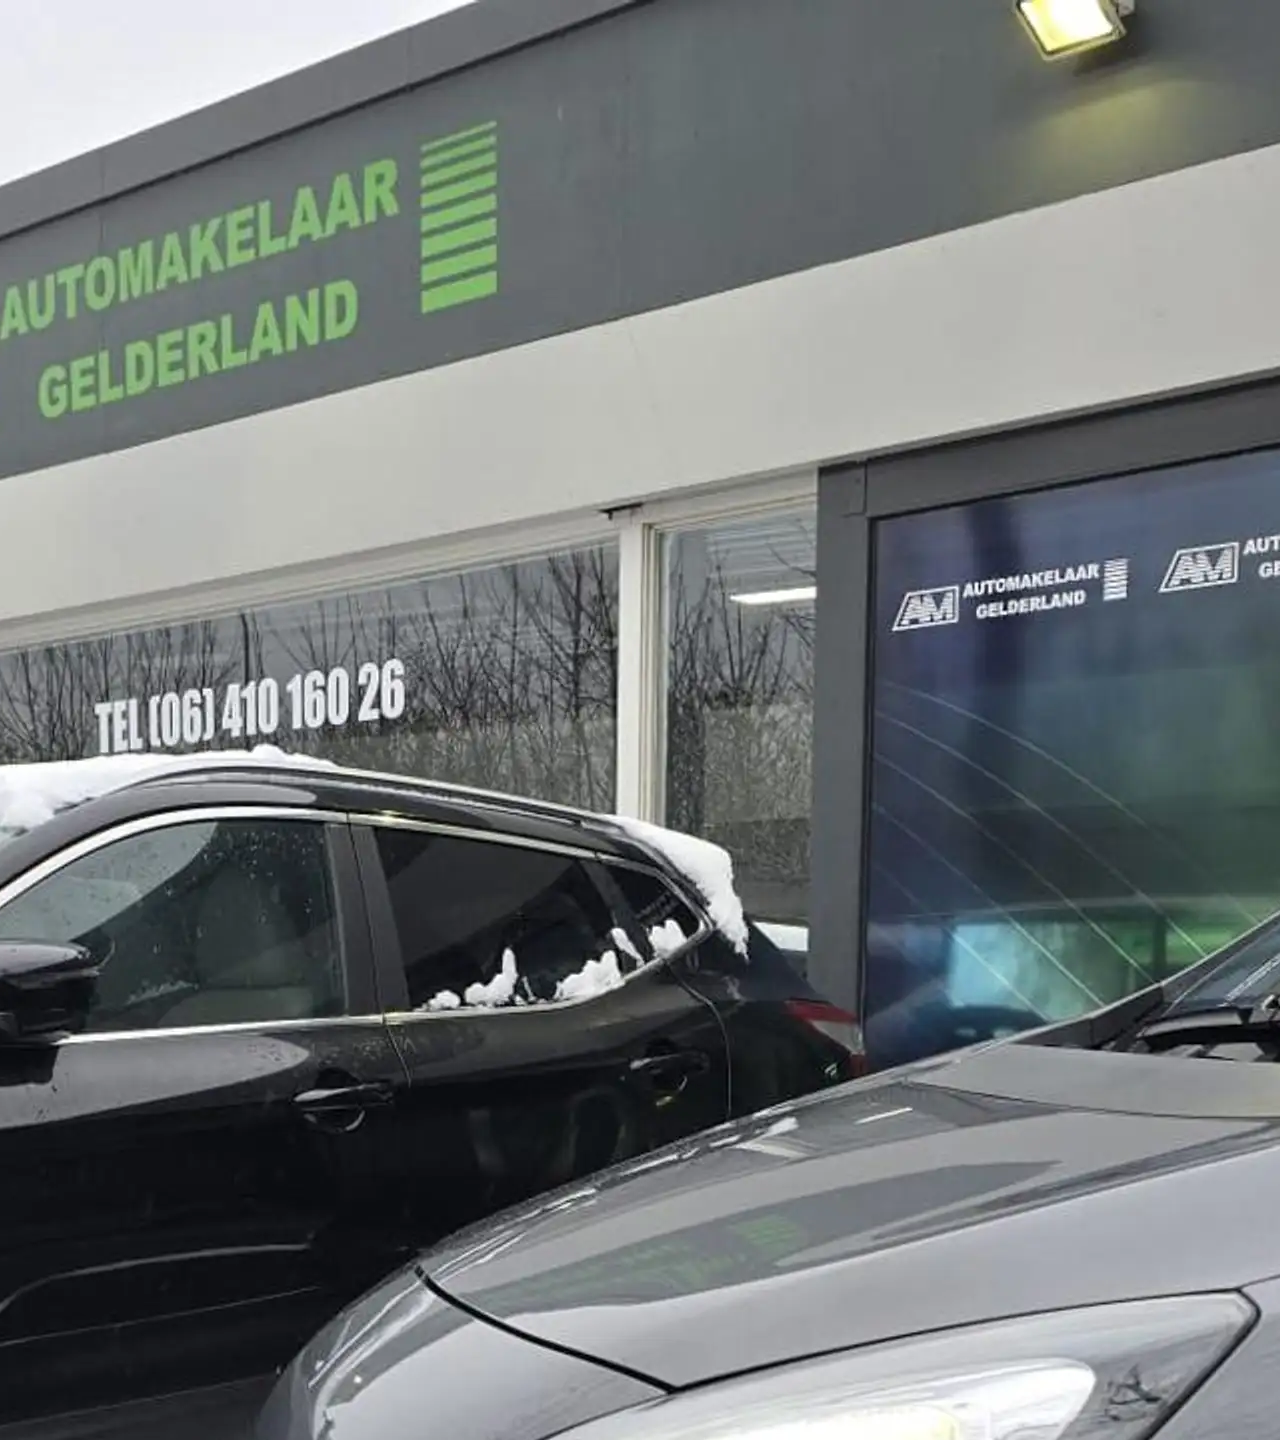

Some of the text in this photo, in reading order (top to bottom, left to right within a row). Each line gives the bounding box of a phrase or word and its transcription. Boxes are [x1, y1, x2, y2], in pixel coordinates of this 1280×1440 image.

[0, 158, 399, 340] AUTOMAKELAAR
[38, 280, 359, 418] GELDERLAND
[963, 563, 1100, 599] AUTOMAKELAAR
[1167, 548, 1236, 590] AM
[898, 593, 957, 628] AM
[975, 589, 1086, 619] GELDERLAND
[94, 698, 143, 753] TEL
[222, 677, 279, 737] 410
[286, 667, 350, 729] 160
[357, 658, 406, 721] 26
